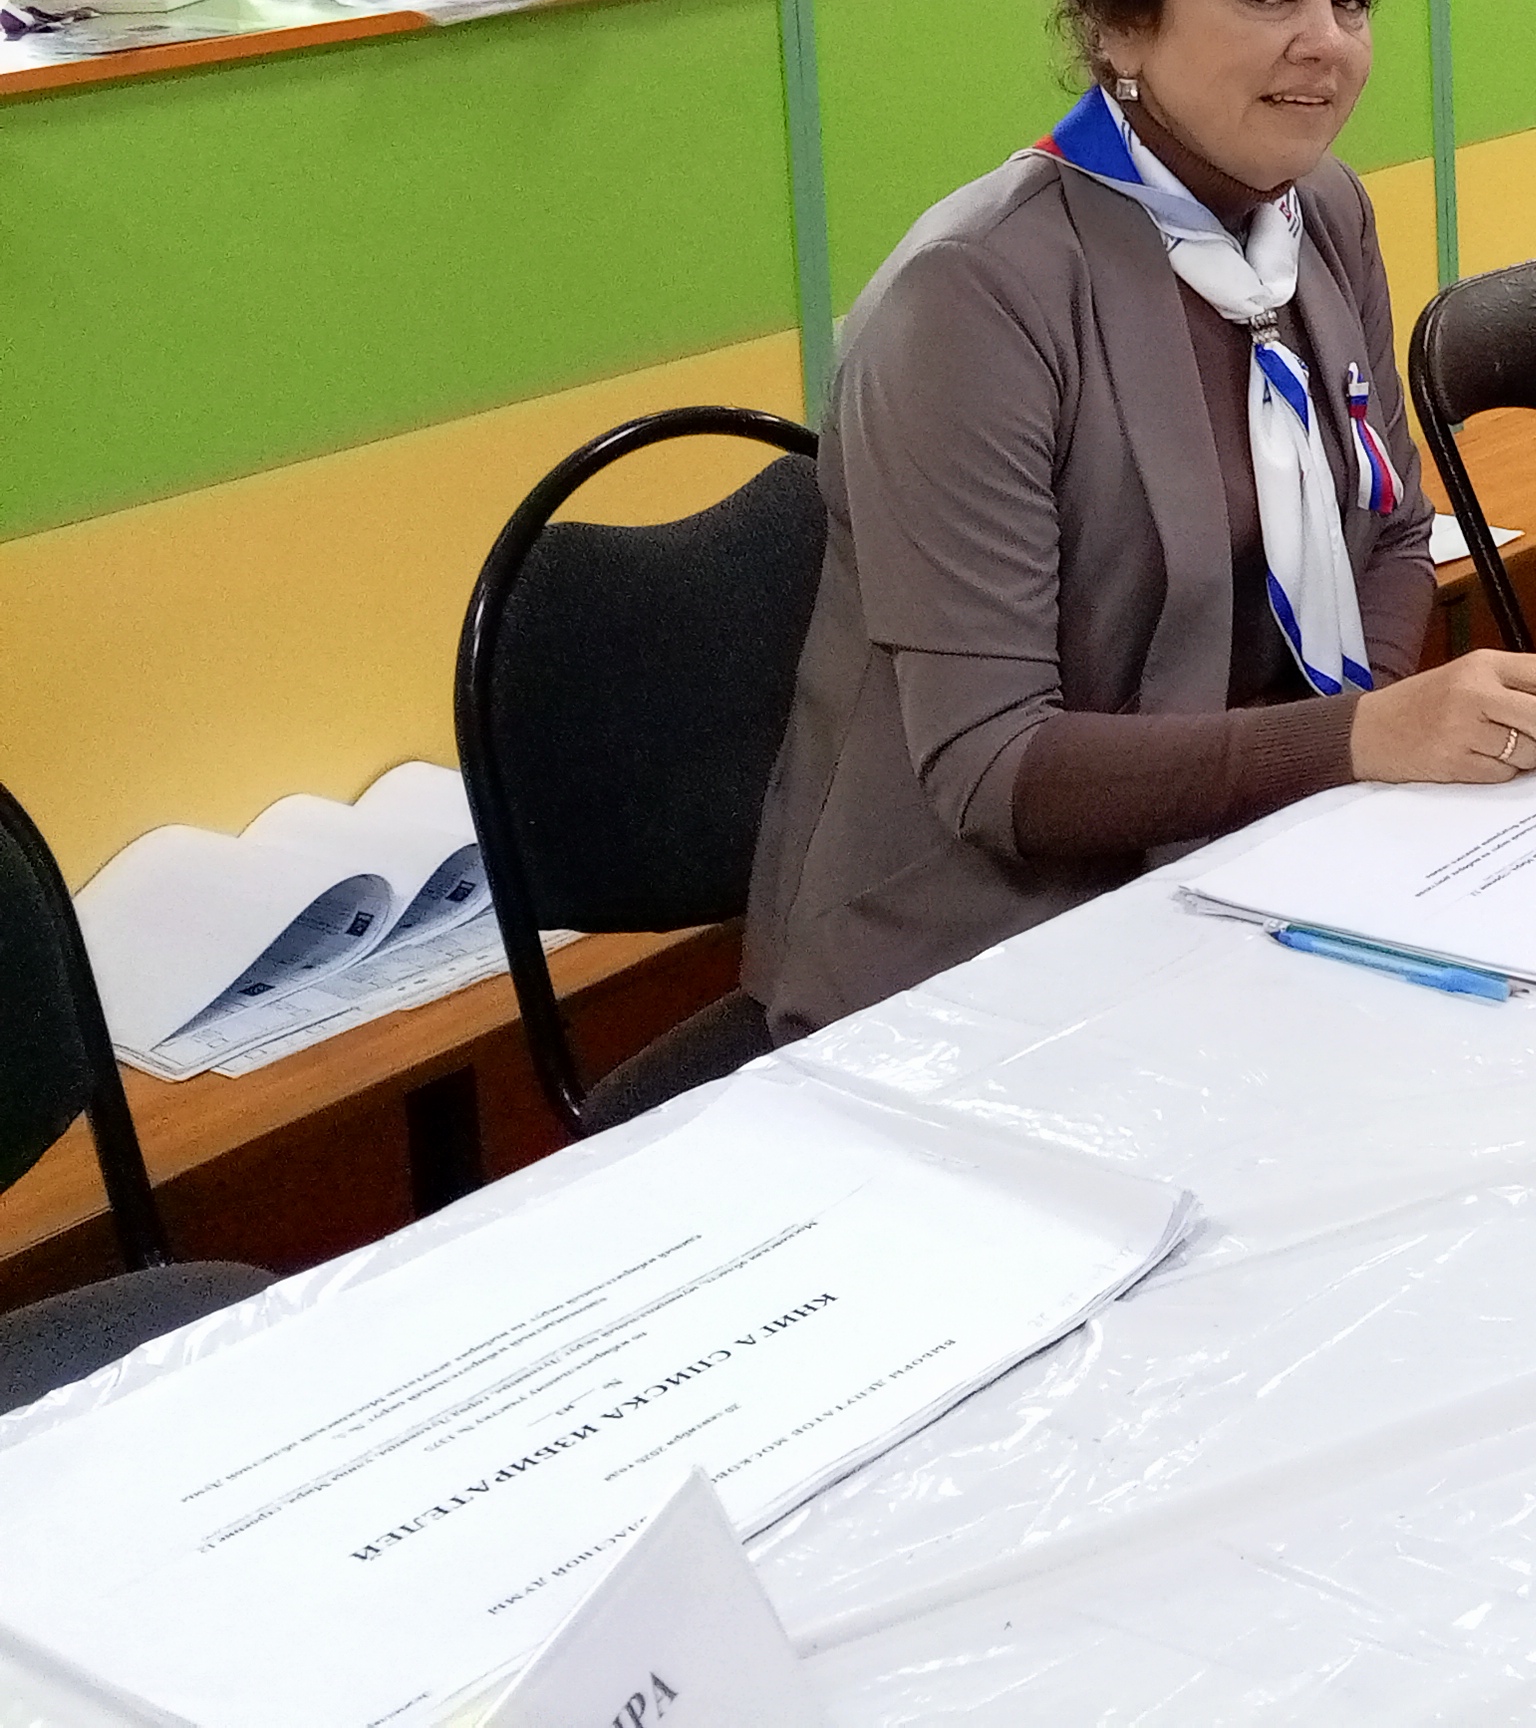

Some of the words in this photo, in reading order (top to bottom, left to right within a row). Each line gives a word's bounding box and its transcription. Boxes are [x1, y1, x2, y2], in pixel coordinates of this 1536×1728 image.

[731, 1290, 842, 1349] КНИГА
[597, 1347, 737, 1424] СПИСКА
[884, 1337, 958, 1380] ВЫБОРЫ
[786, 1377, 890, 1438] ДЕПУТАТОВ
[705, 1435, 792, 1485] МОСКОВС
[346, 1421, 601, 1565] ИЗБИРАТЕЛЕЙ
[548, 1514, 654, 1579] ЛАСТНОЙ
[483, 1575, 552, 1617] ДУМЫ
